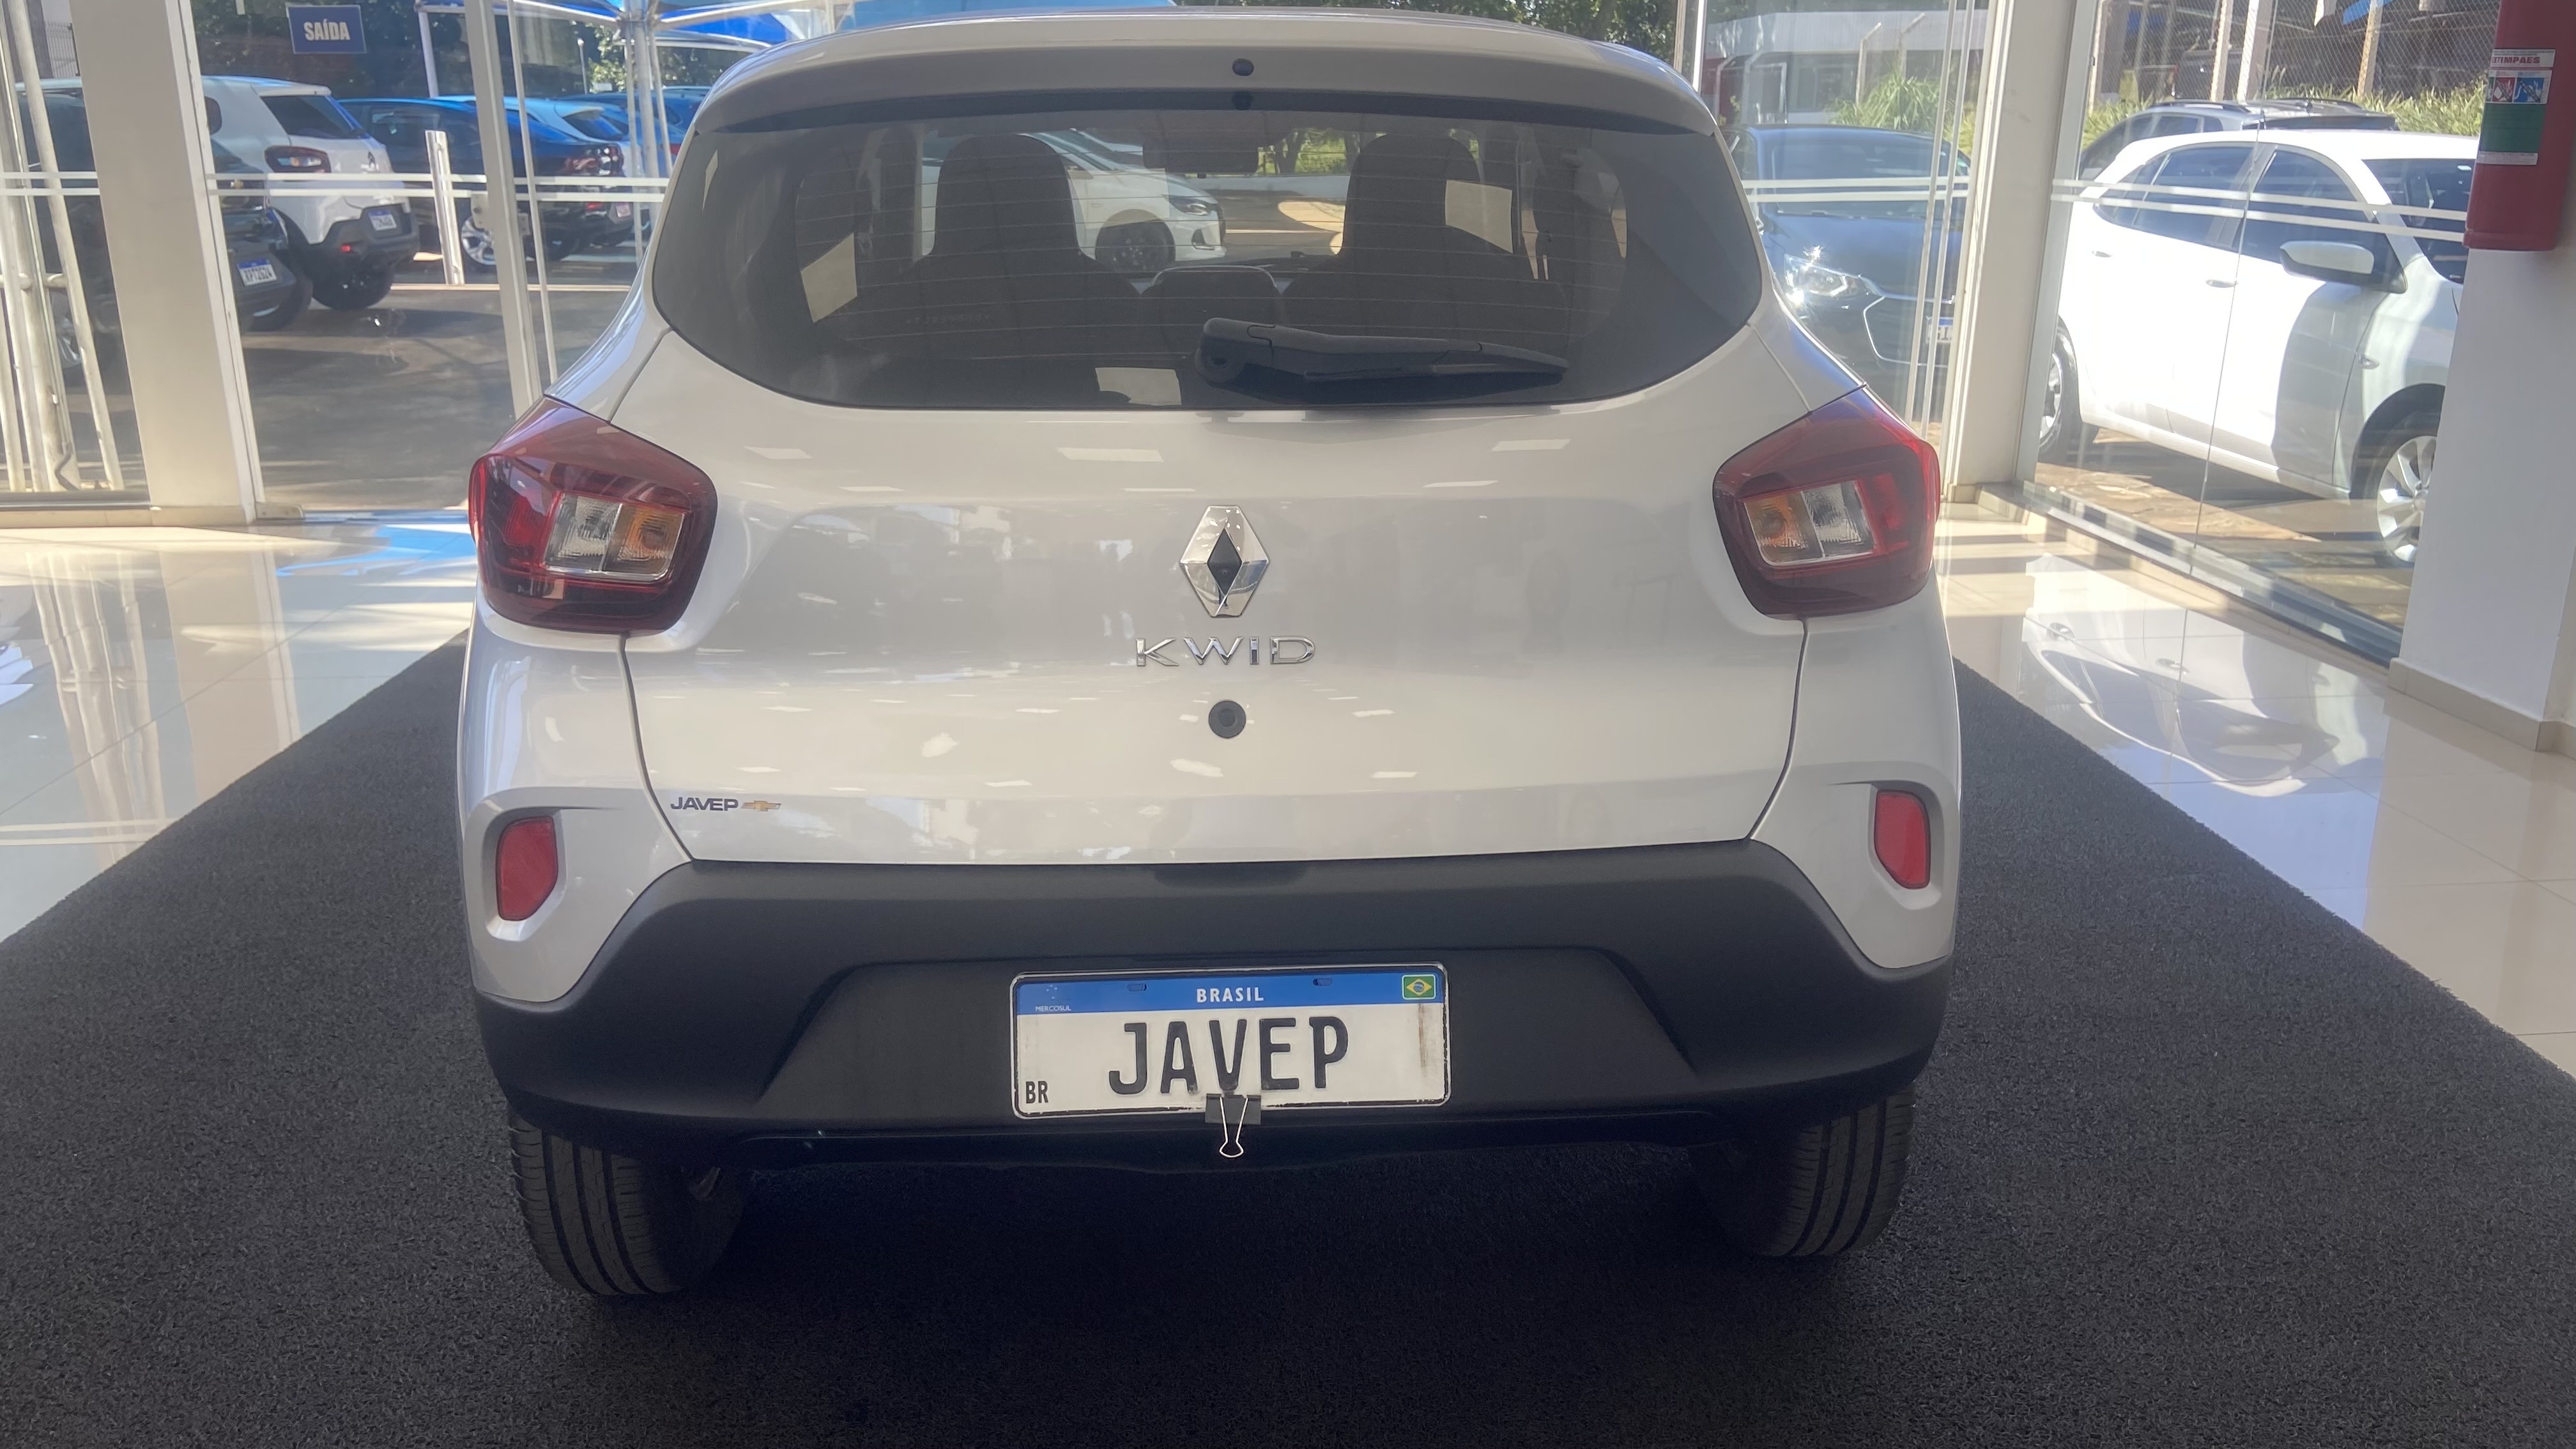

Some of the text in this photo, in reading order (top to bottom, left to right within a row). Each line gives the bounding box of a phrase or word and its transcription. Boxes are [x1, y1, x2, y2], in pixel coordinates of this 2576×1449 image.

[303, 18, 351, 41] SAÍDA
[1136, 636, 1315, 666] KWID
[671, 797, 739, 811] JAVEP
[1197, 987, 1264, 1002] BRASIL
[1108, 1016, 1349, 1094] JAVEP
[1026, 1080, 1048, 1103] BR
